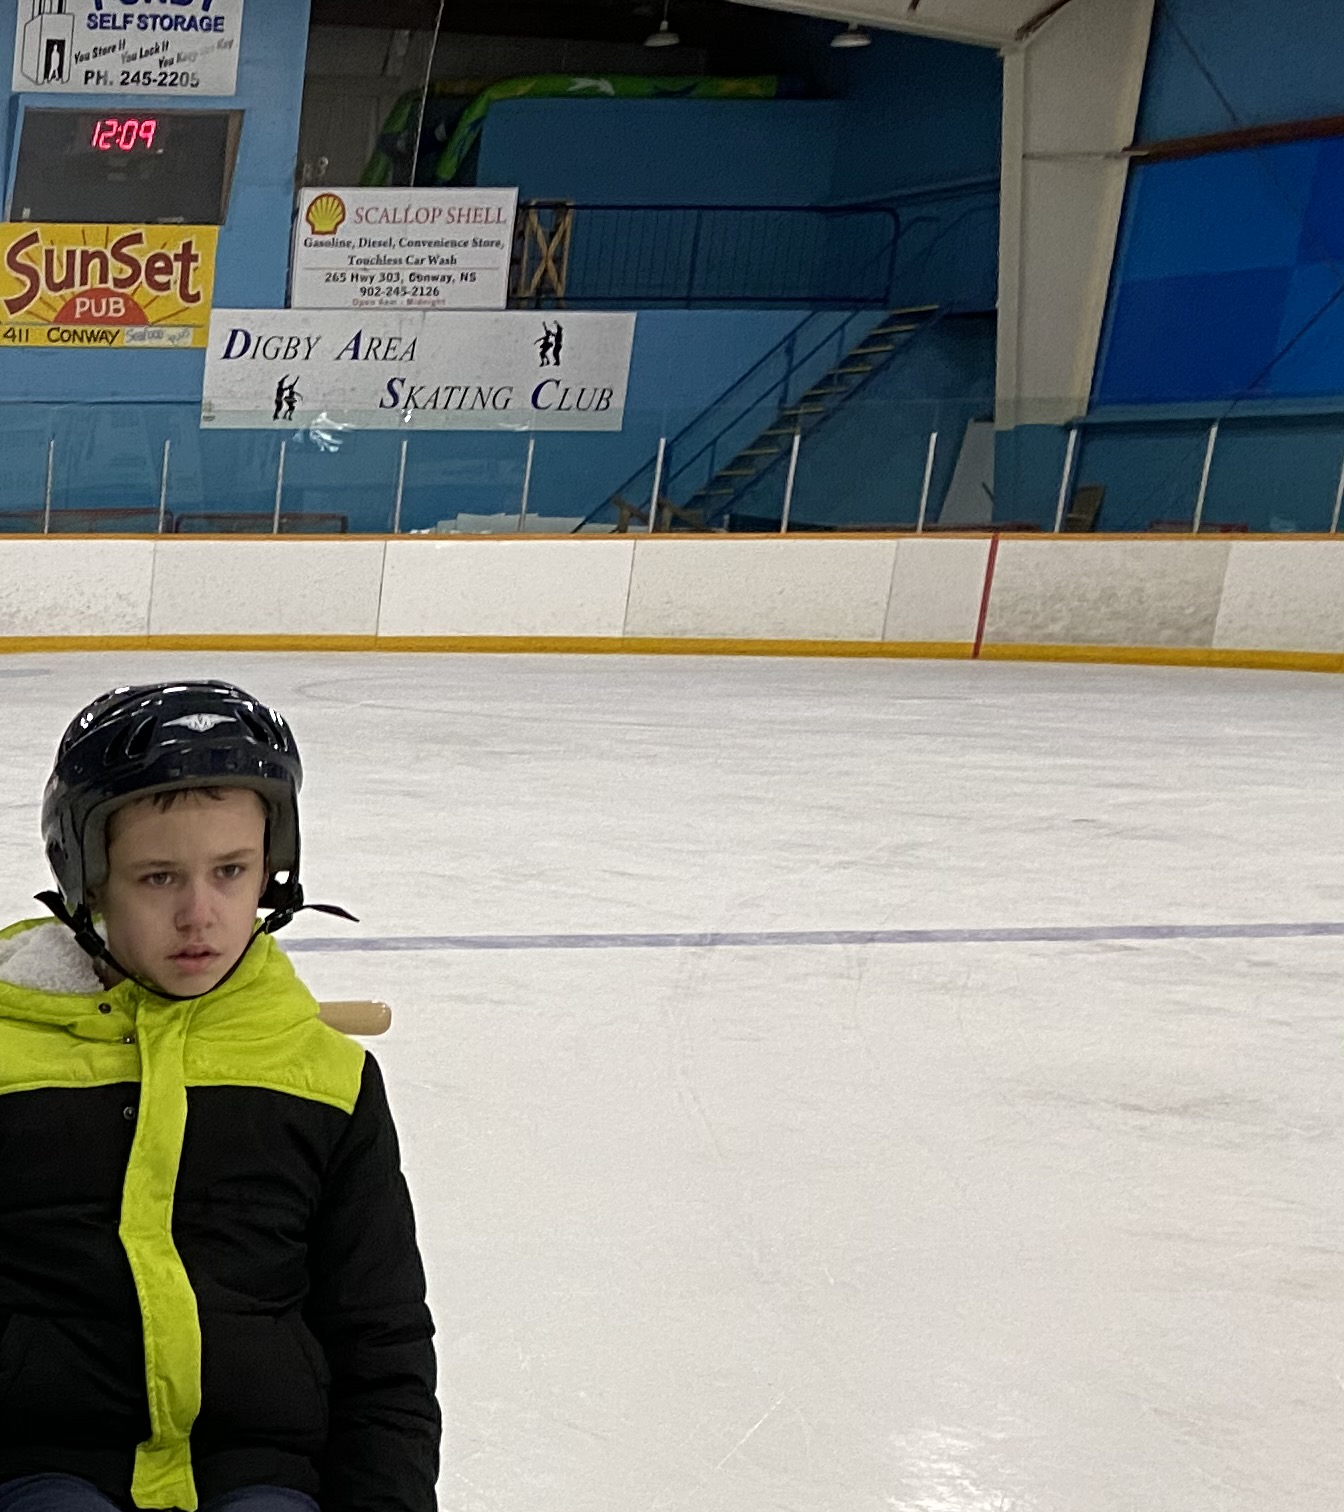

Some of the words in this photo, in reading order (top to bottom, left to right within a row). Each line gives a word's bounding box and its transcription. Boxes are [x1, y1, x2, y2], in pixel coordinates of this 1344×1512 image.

[87, 13, 134, 31] SELF
[137, 14, 225, 33] STORAGE
[74, 51, 90, 64] You
[121, 52, 137, 64] You
[84, 71, 113, 86] PH.
[120, 71, 200, 88] 245-2205
[91, 119, 157, 150] 12:09
[354, 206, 443, 225] SCALLOP
[446, 207, 507, 225] SHELL
[303, 237, 356, 250] Gasoline,
[358, 237, 396, 250] Diesel,
[398, 237, 471, 248] Convenience
[471, 238, 504, 250] Store,
[347, 255, 403, 266] Touchless
[405, 255, 424, 266] Car
[427, 255, 457, 266] Wash
[3, 230, 202, 316] SunSet
[325, 272, 347, 283] 265
[350, 273, 375, 284] Hwy
[378, 272, 404, 284] 303,
[408, 272, 455, 284] Conway,
[359, 286, 440, 297] 902-245-2126
[74, 297, 126, 318] PUB
[3, 328, 30, 342] 411
[47, 327, 120, 345] CONWAY
[220, 328, 324, 361] DIGBY
[334, 329, 417, 361] AREA
[379, 378, 515, 411] SKATING
[530, 378, 614, 411] CLUB
